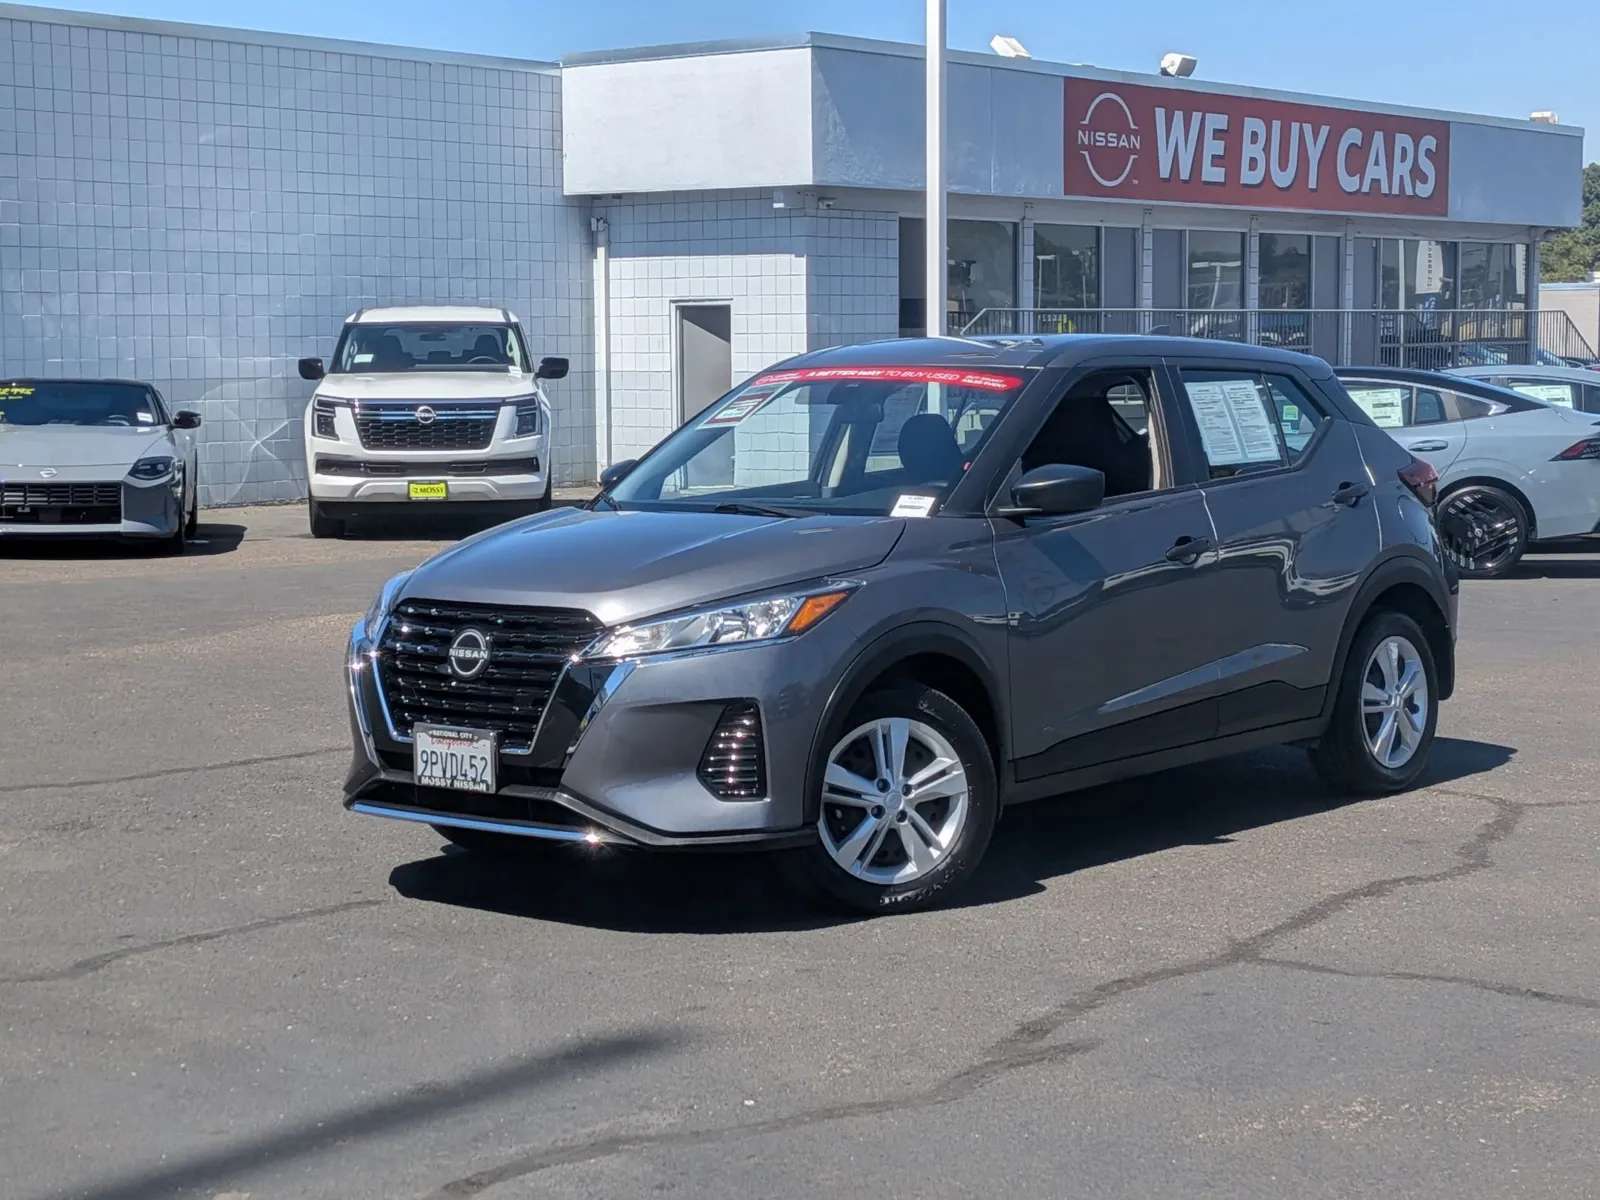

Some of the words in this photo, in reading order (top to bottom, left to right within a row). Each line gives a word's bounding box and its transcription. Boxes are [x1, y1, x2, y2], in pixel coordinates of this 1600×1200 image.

[1077, 129, 1141, 150] NISSAN
[1154, 107, 1229, 184] WE
[1240, 117, 1331, 191] BUY
[1336, 127, 1438, 199] CARS
[901, 370, 928, 378] BUY
[927, 372, 960, 381] USED
[419, 486, 444, 494] MOSSY
[448, 648, 488, 660] NISSAN
[432, 729, 459, 738] NATIONAL
[420, 749, 489, 784] 9PVD452
[421, 776, 452, 788] MOSSY
[453, 779, 487, 792] NISSAN
